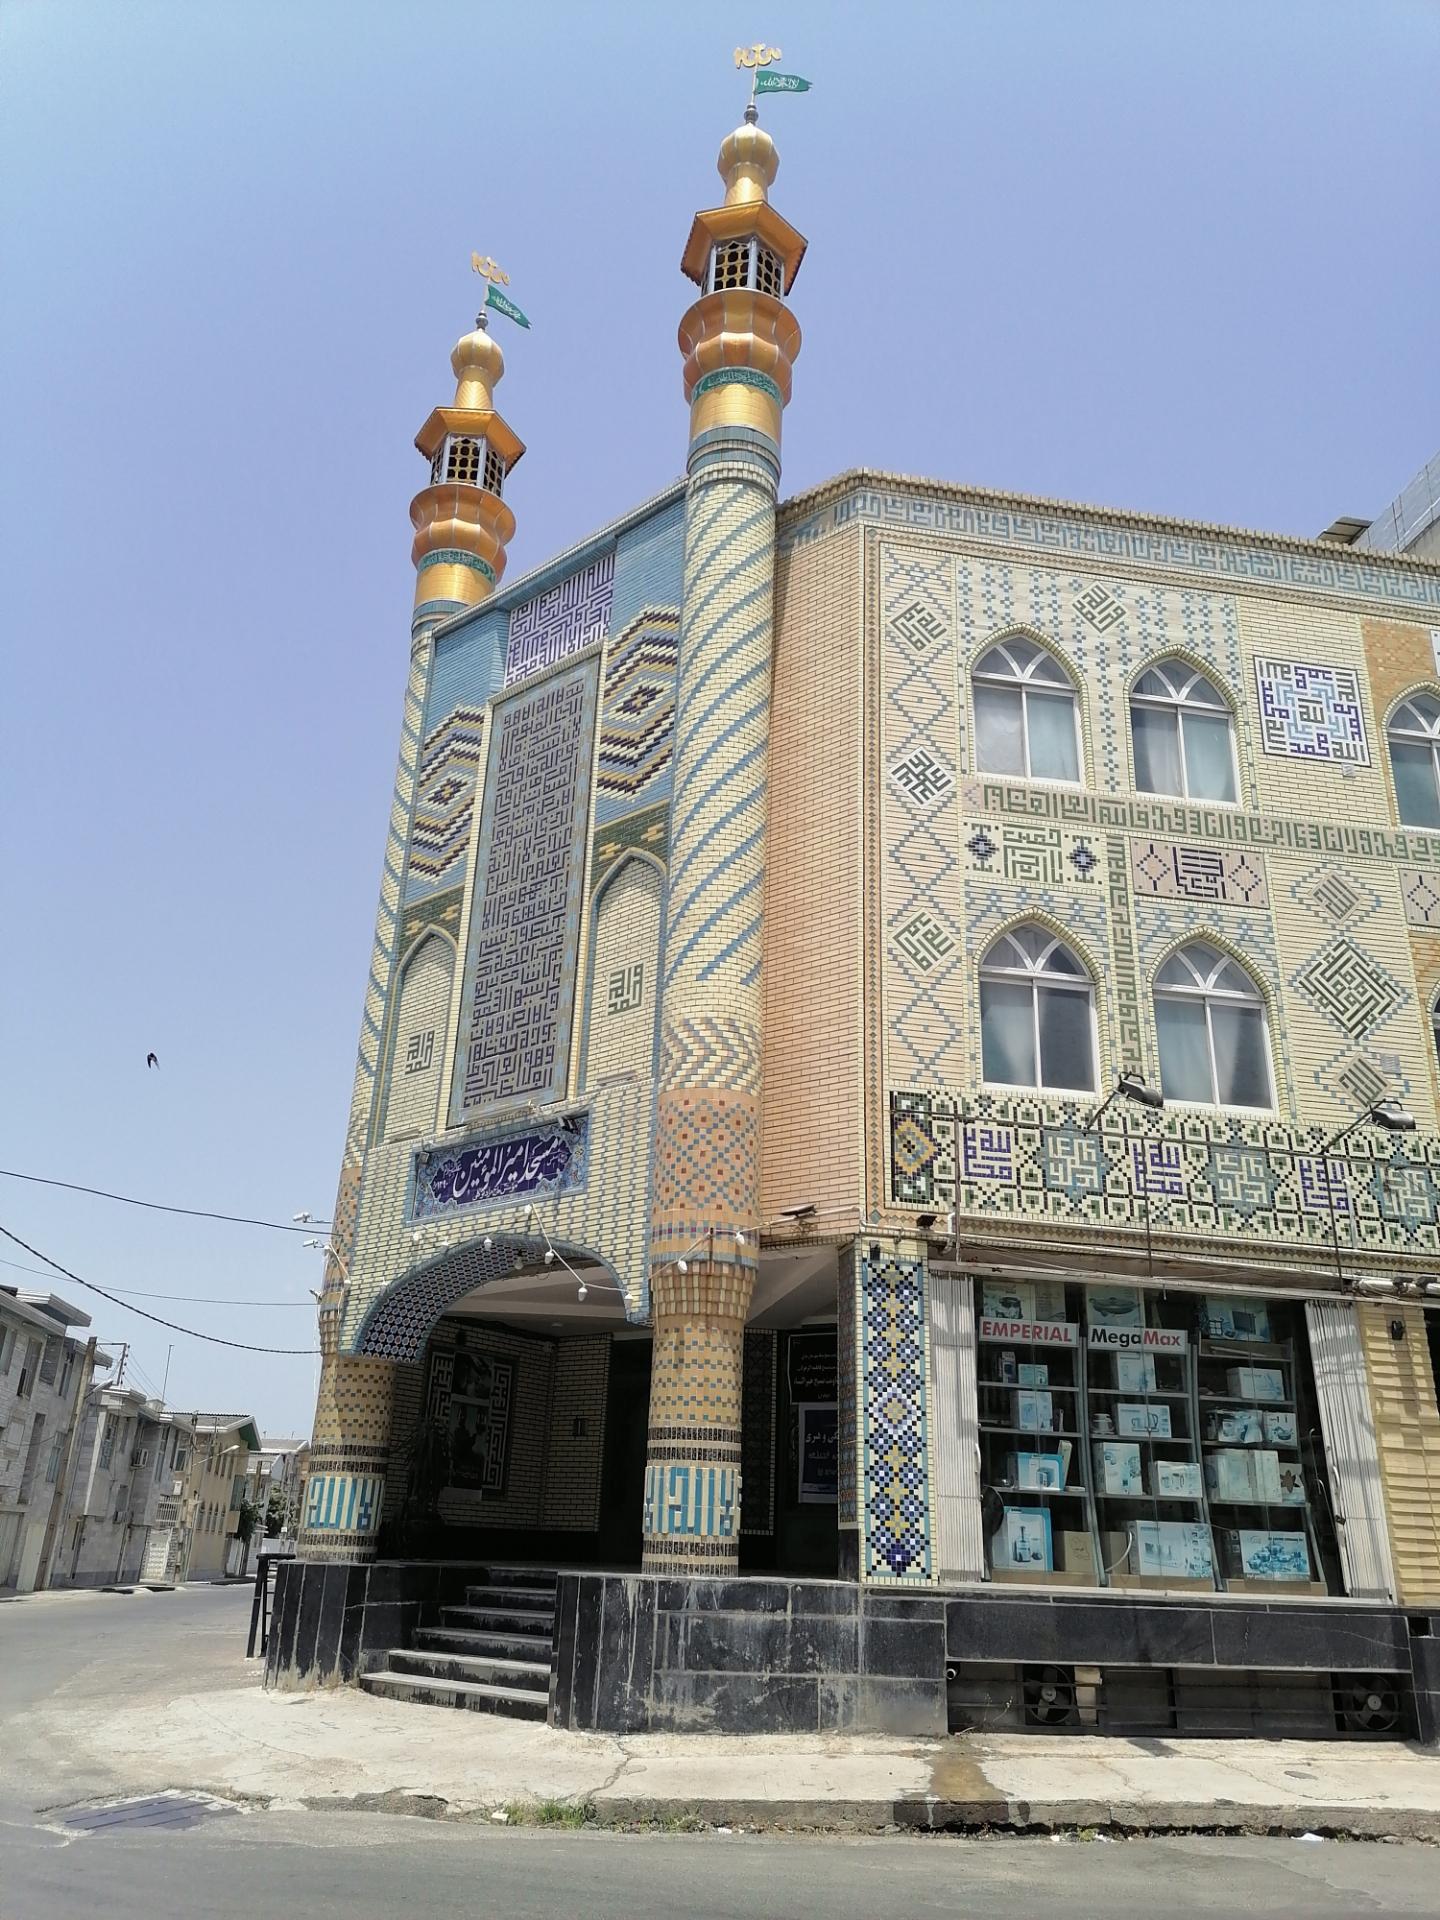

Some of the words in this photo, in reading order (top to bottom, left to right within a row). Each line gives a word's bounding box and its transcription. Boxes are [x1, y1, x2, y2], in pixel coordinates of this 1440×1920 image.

[518, 1136, 560, 1184] مسجد
[982, 1321, 1072, 1343] EMPERIAL
[1091, 1328, 1180, 1348] MegaMax
